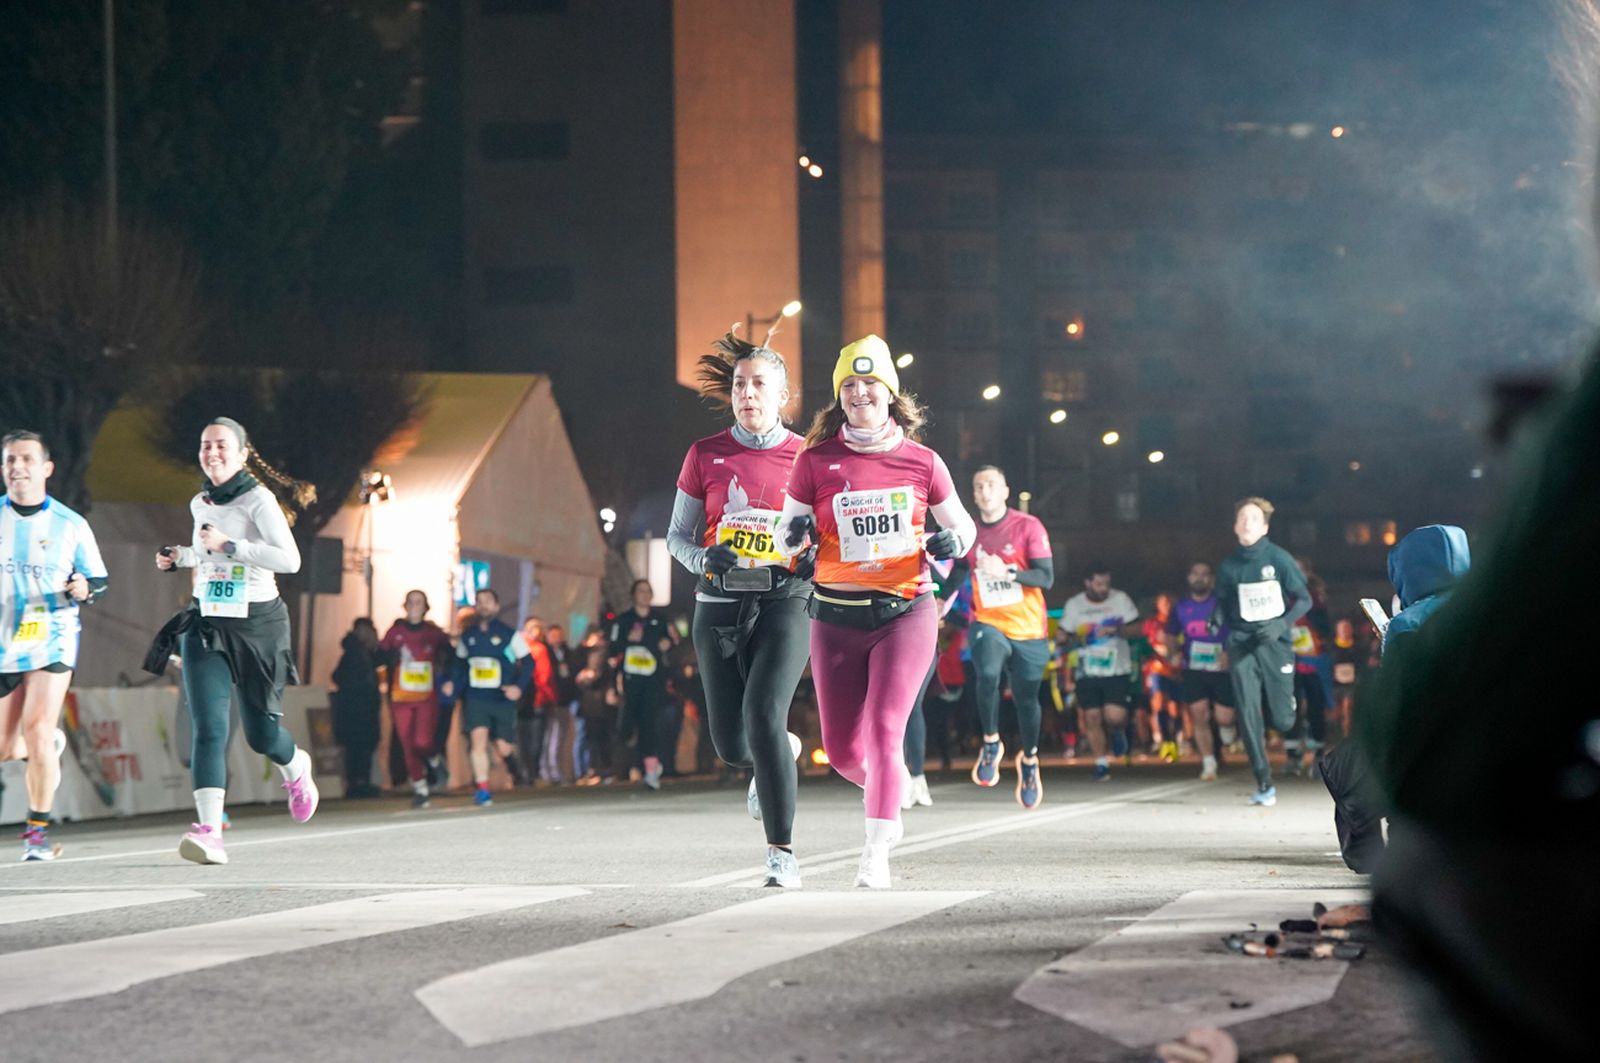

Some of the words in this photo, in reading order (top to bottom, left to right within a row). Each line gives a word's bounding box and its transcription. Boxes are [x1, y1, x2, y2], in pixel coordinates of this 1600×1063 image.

[843, 508, 858, 517] SAN
[852, 513, 899, 536] 6081
[733, 530, 775, 553] 6767
[208, 581, 234, 598] 786
